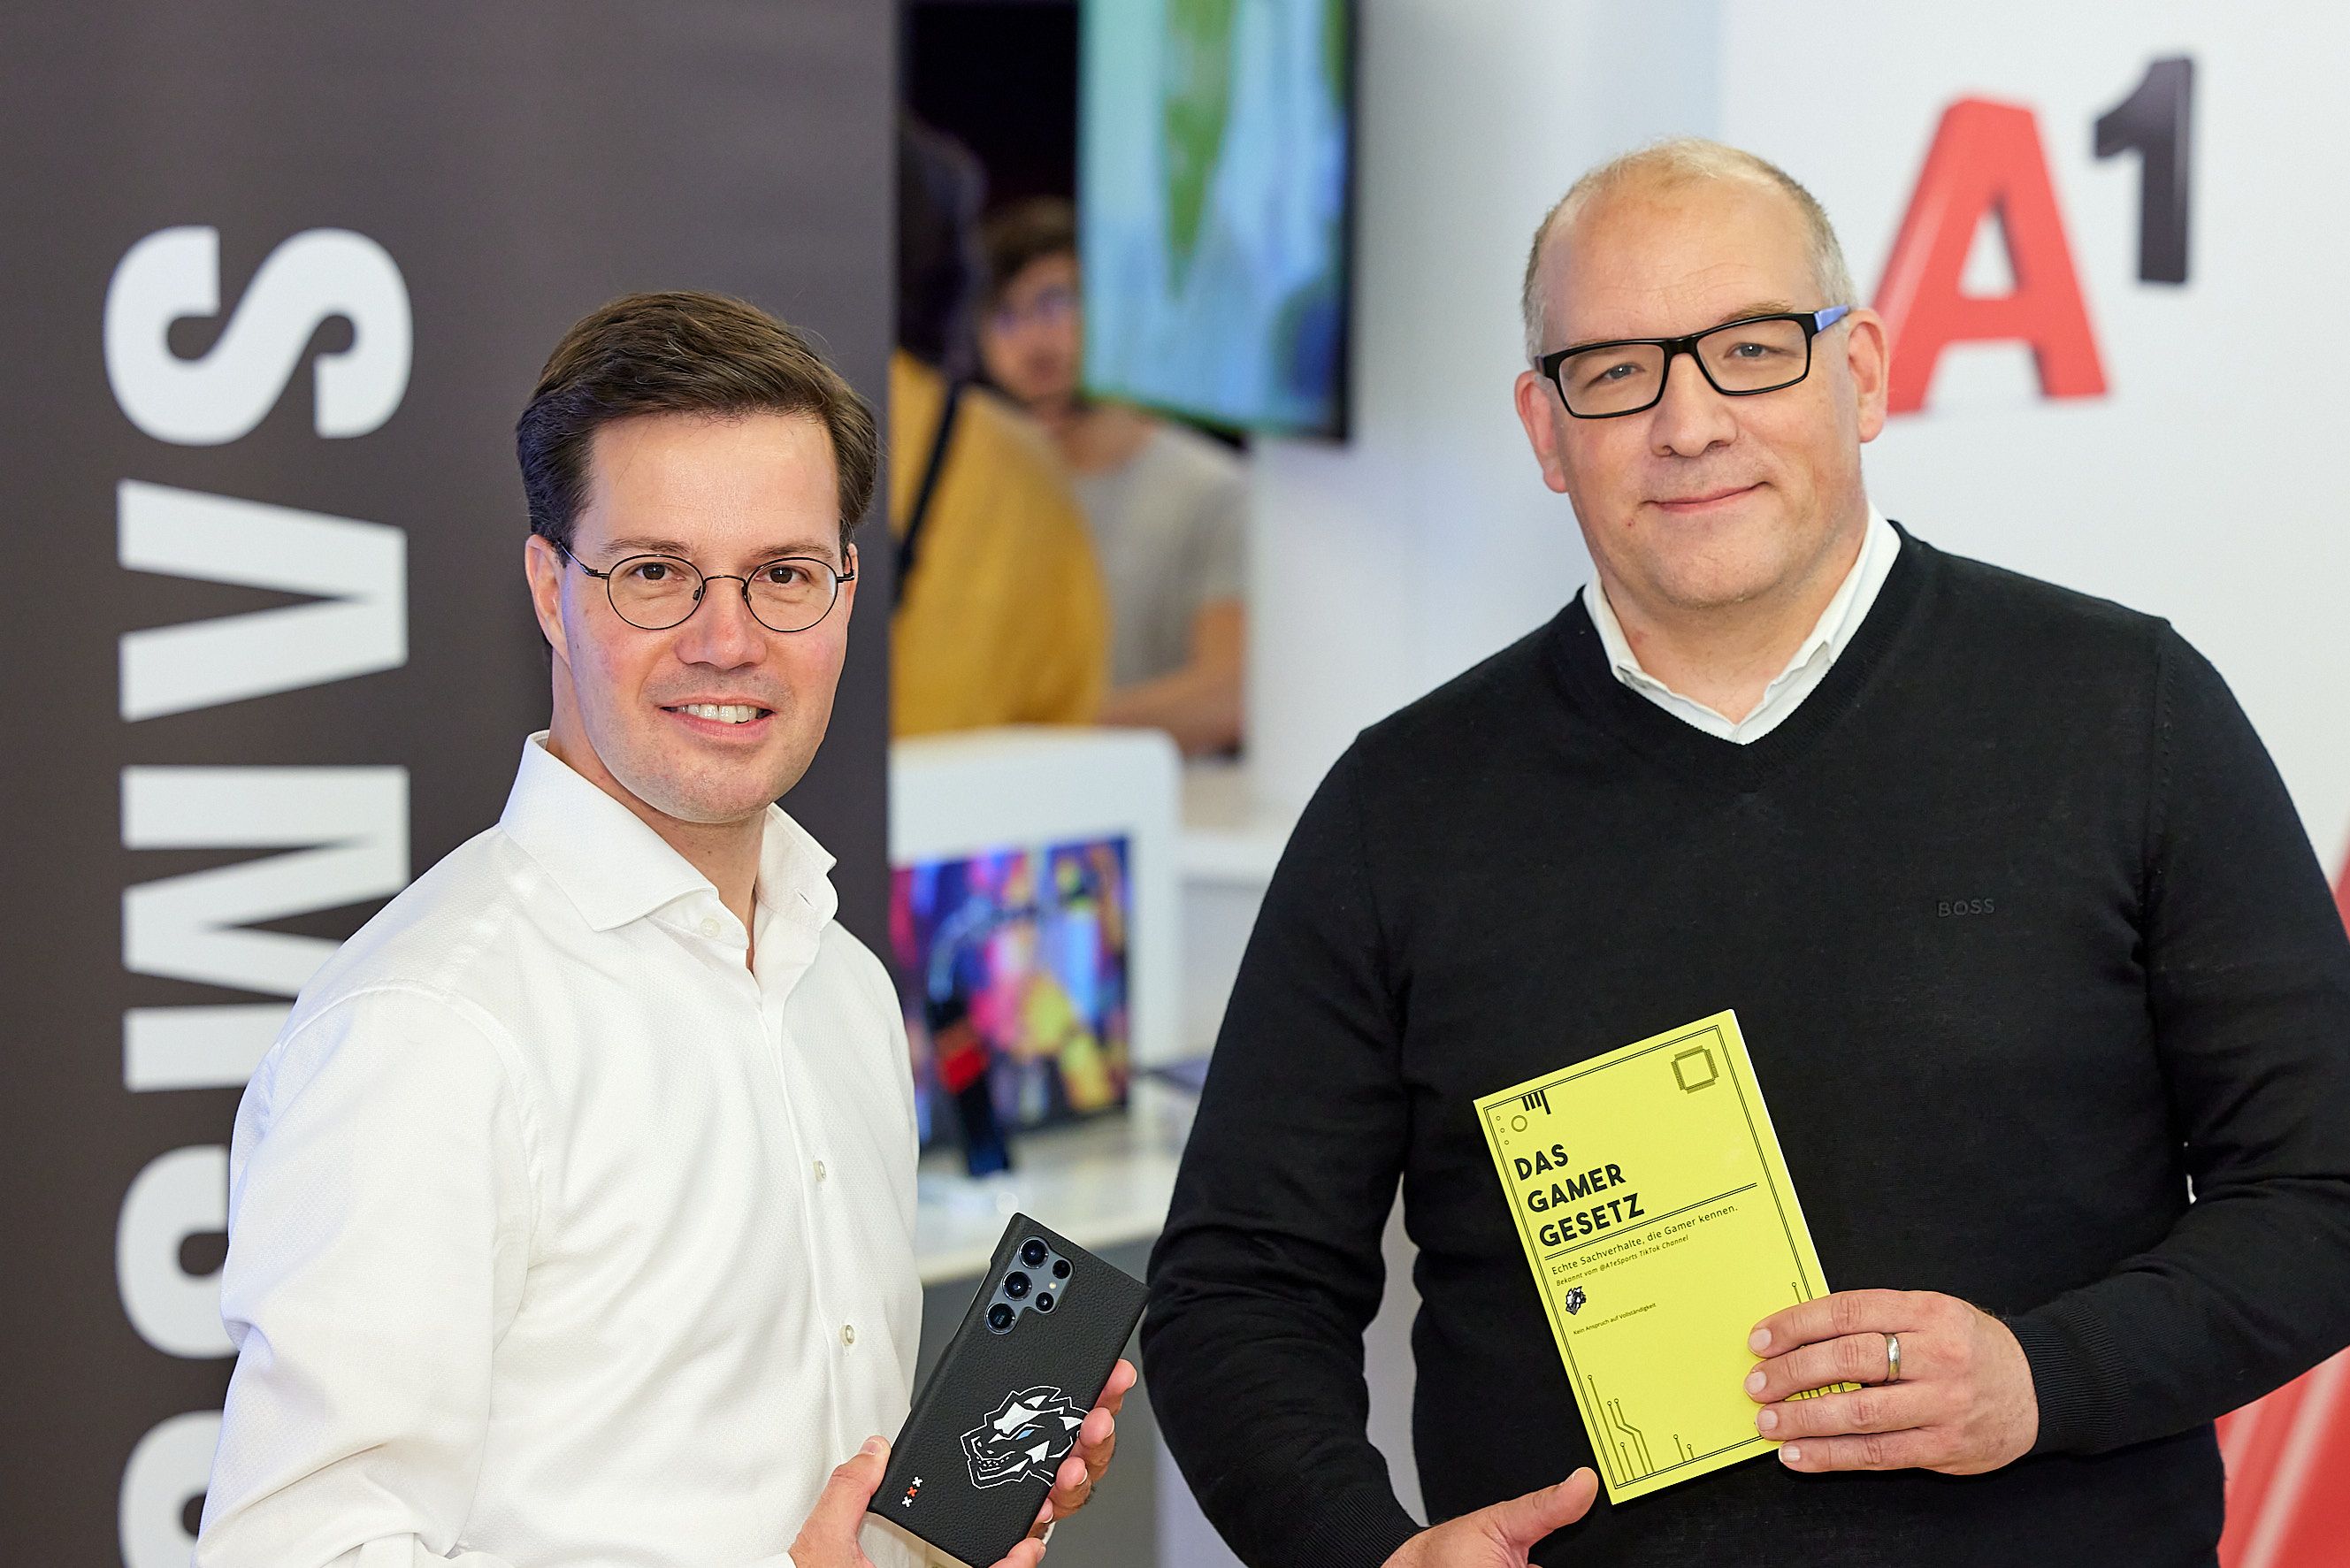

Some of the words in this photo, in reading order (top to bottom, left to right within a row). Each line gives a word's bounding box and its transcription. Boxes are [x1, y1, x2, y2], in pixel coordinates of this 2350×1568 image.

[1868, 58, 2193, 418] A1
[103, 224, 414, 1567] SAM
[1937, 899, 1995, 918] BOSS
[1513, 1143, 1568, 1181] DAS
[1527, 1163, 1627, 1212] GAMER
[1539, 1192, 1645, 1247] GESETZ
[1551, 1259, 1579, 1275] Echte
[1580, 1238, 1646, 1266] Sachverhalte,
[1647, 1231, 1662, 1242] die
[1664, 1219, 1696, 1235] Gamer
[1698, 1205, 1738, 1223] kennen.
[1556, 1272, 1583, 1287] Bekannt
[1584, 1267, 1598, 1276] vom
[1599, 1253, 1638, 1273] @A1eSports
[1639, 1245, 1660, 1257] TikTok
[1662, 1235, 1689, 1249] Channel
[1573, 1327, 1585, 1335] Kein
[1585, 1319, 1610, 1332] Anspruch
[1619, 1303, 1657, 1320] Vollständigkeit
